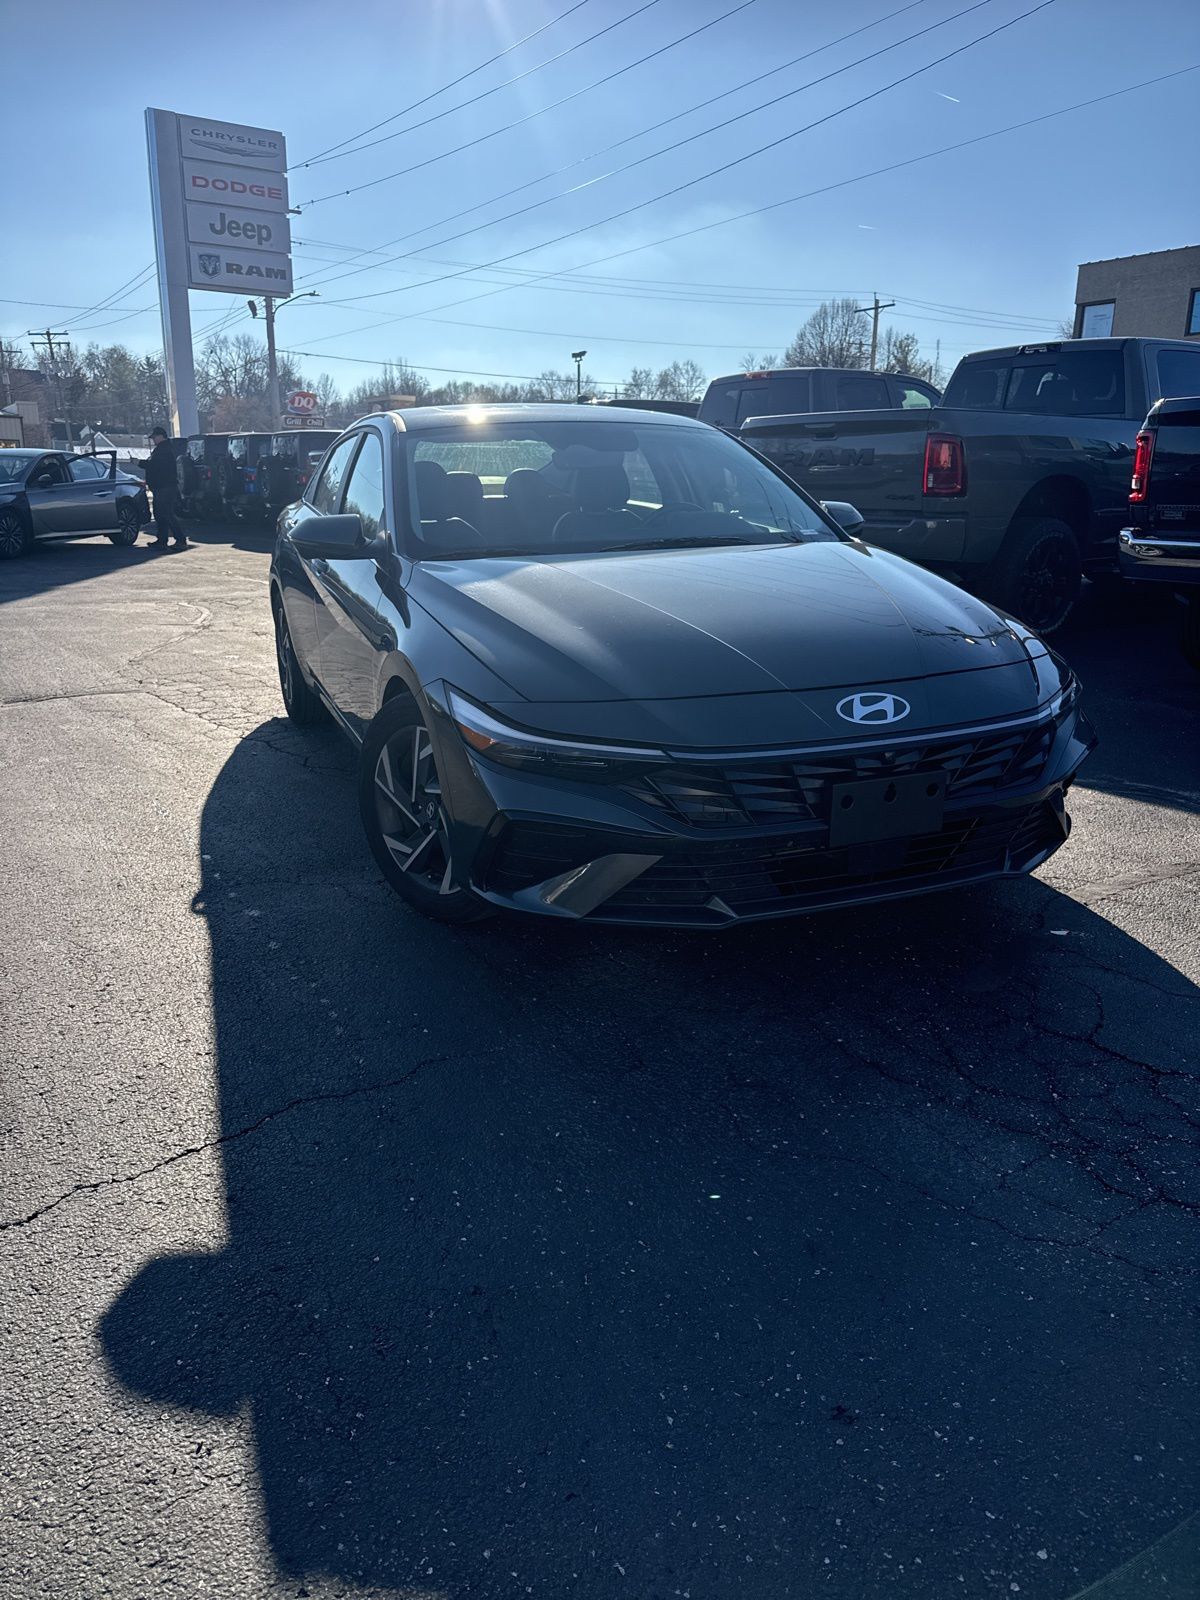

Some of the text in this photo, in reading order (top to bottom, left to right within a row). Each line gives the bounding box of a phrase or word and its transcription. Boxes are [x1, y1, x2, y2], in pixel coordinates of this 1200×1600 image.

[191, 128, 278, 149] CHRYSLER
[191, 175, 283, 200] DODGE
[209, 212, 272, 245] Jeep
[225, 262, 287, 280] RAM
[294, 396, 314, 409] DQ
[781, 447, 876, 467] RAM
